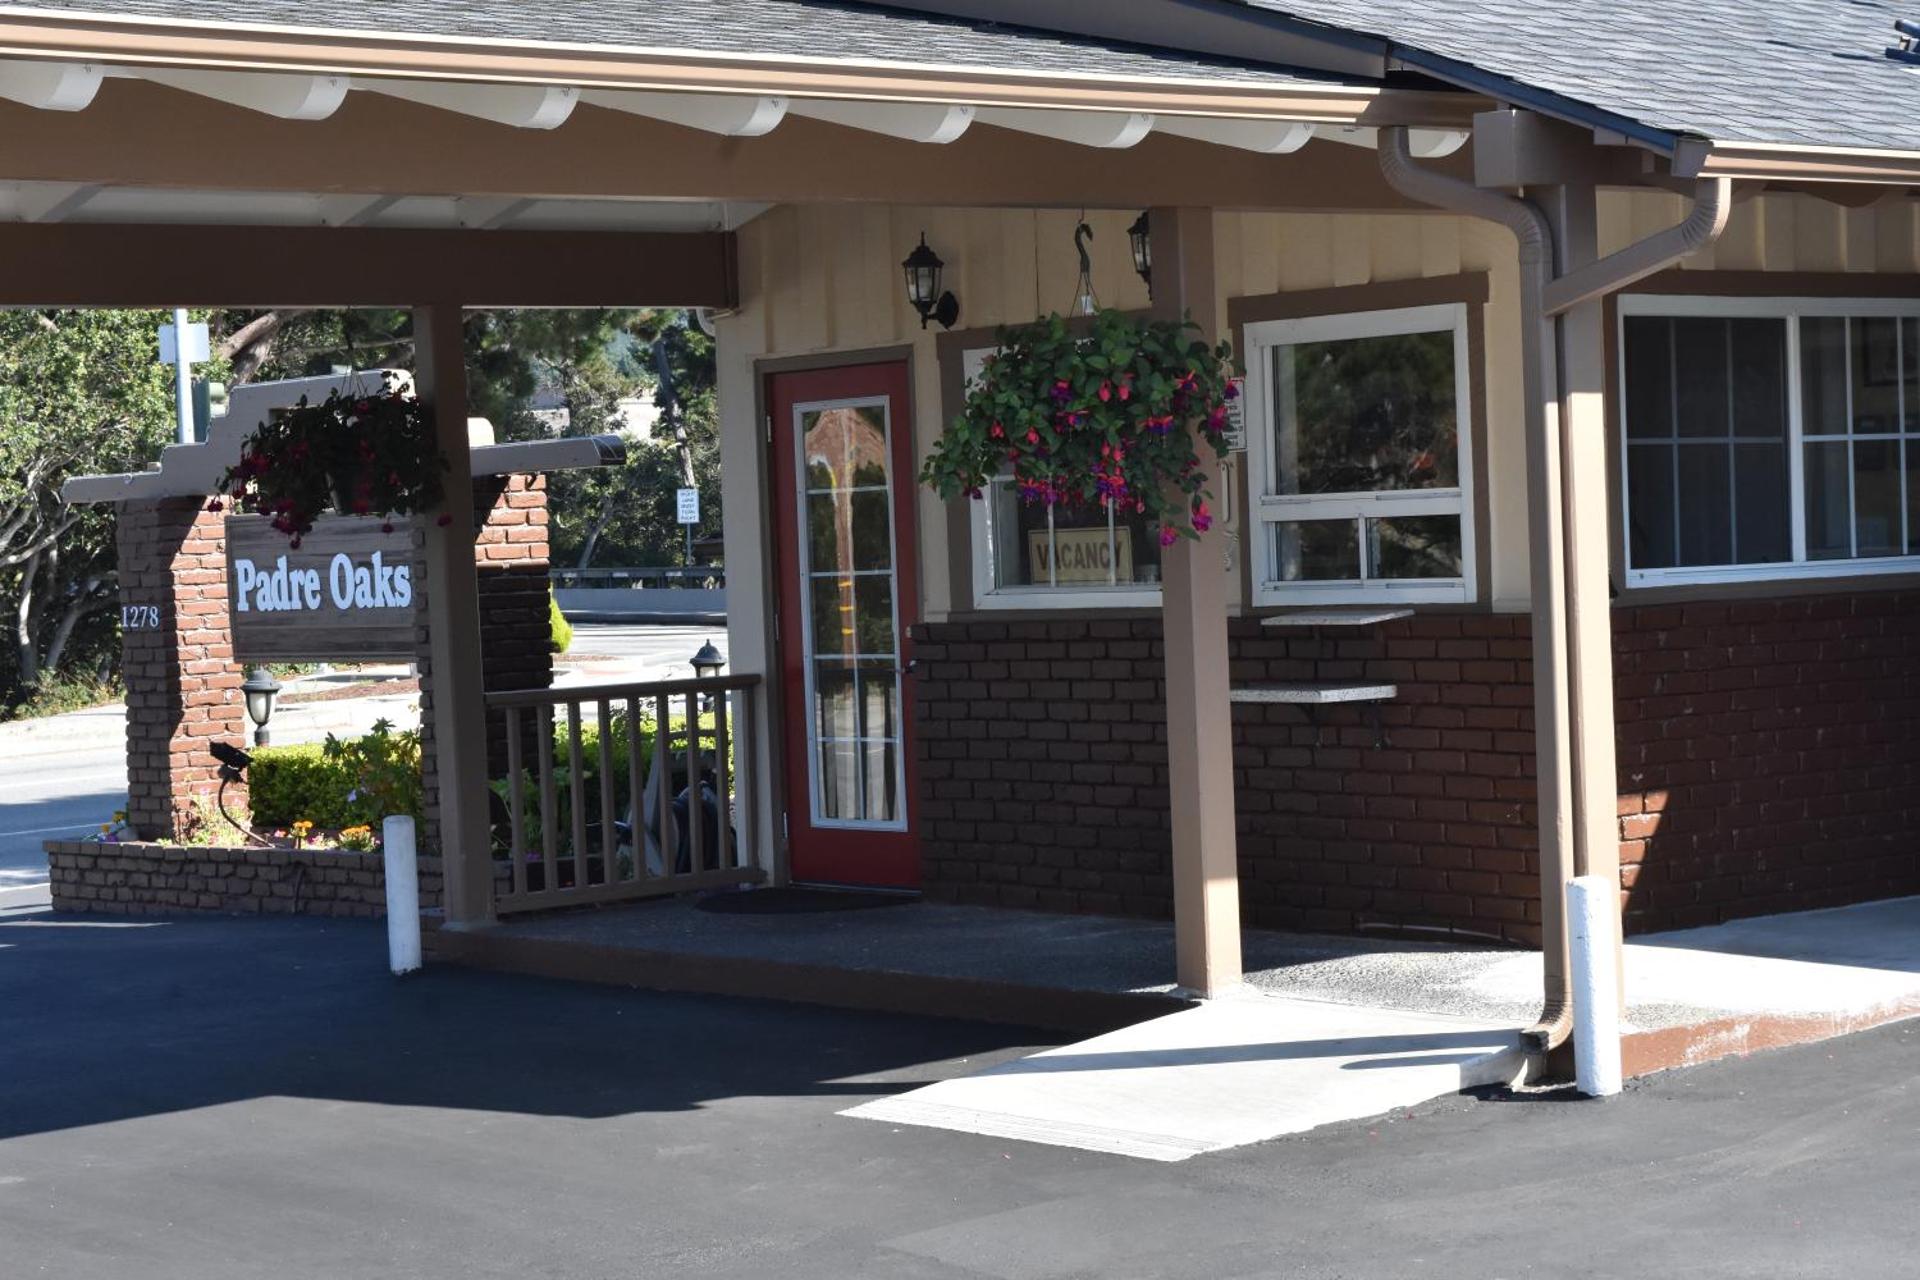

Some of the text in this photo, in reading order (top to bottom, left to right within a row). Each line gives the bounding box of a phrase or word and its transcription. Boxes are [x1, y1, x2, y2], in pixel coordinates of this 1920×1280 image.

[234, 550, 412, 612] Padre Oaks
[122, 605, 159, 628] 1278
